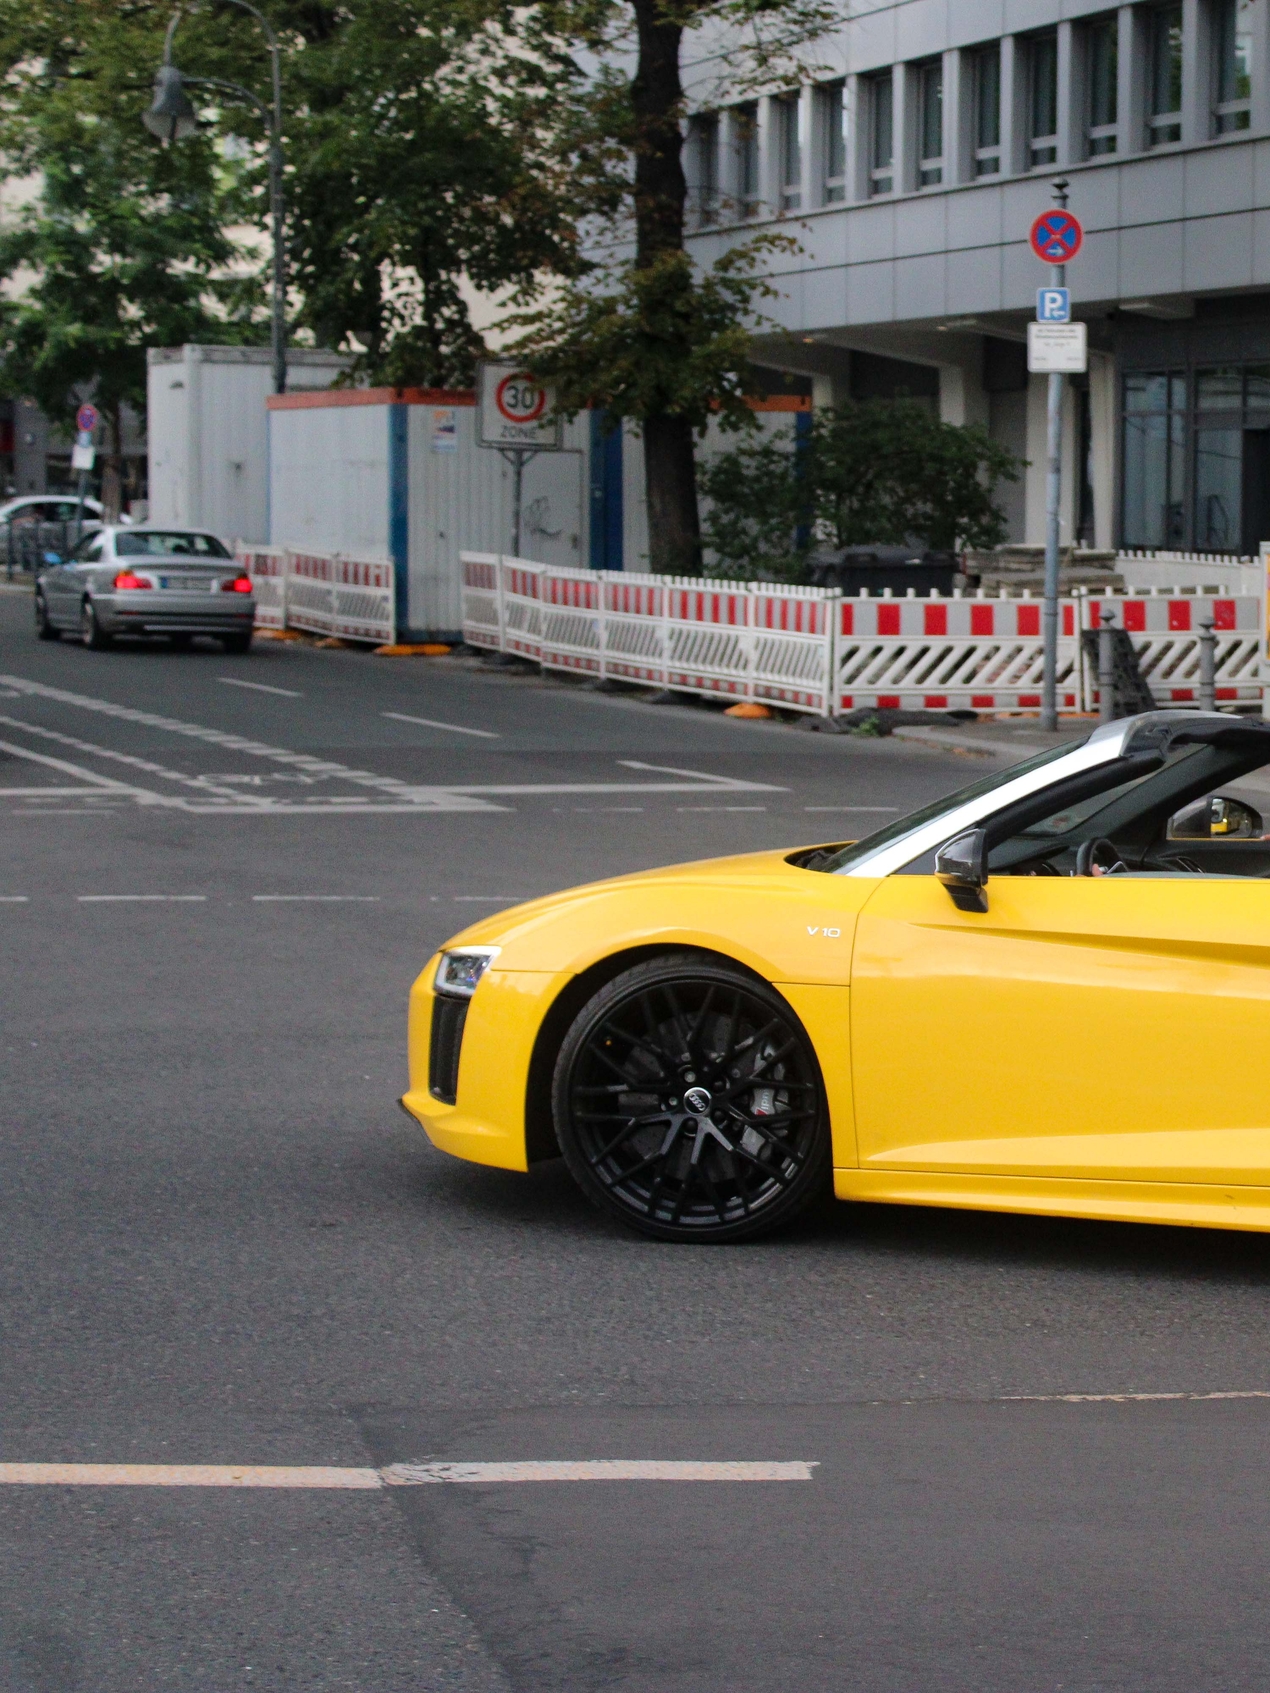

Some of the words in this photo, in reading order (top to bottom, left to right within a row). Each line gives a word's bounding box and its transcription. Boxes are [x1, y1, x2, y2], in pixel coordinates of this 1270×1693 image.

[1044, 292, 1063, 318] P
[506, 385, 535, 410] 30
[501, 424, 540, 439] ZONE
